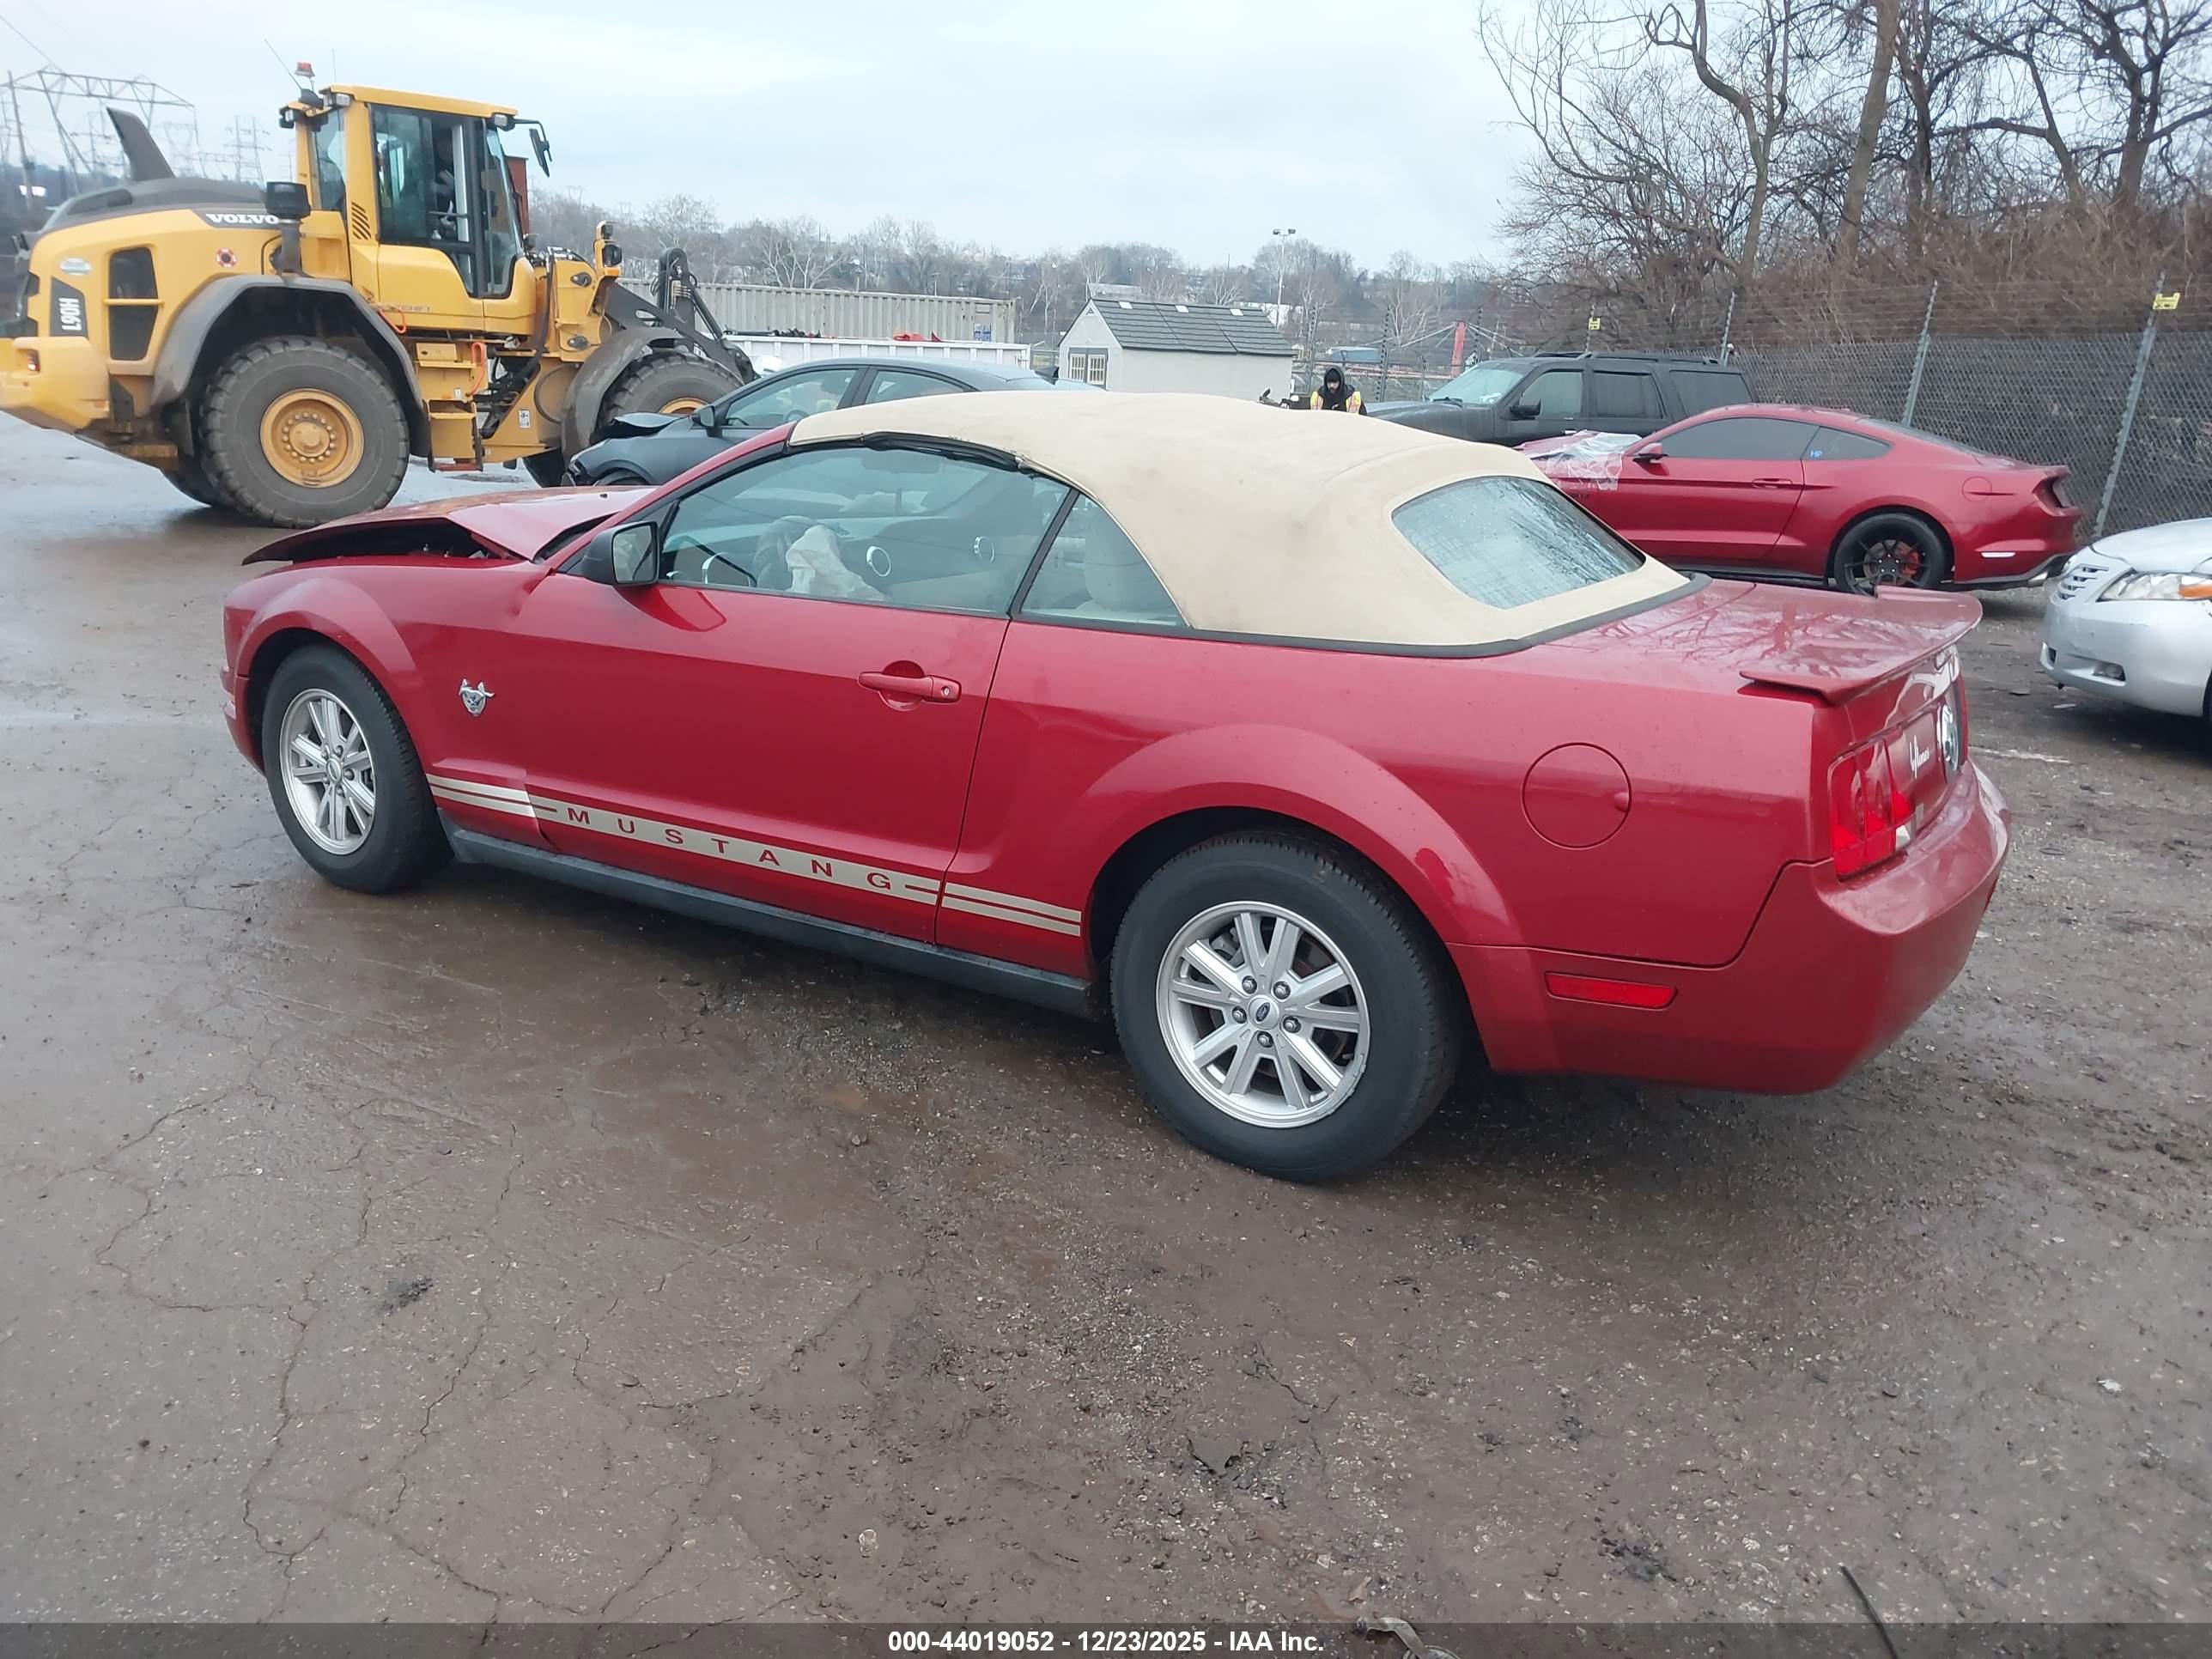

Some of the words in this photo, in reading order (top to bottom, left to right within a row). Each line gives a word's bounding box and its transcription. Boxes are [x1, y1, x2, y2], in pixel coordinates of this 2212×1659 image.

[205, 213, 279, 224] VOLVO
[58, 297, 82, 331] L90H
[567, 806, 891, 890] MUSTANG
